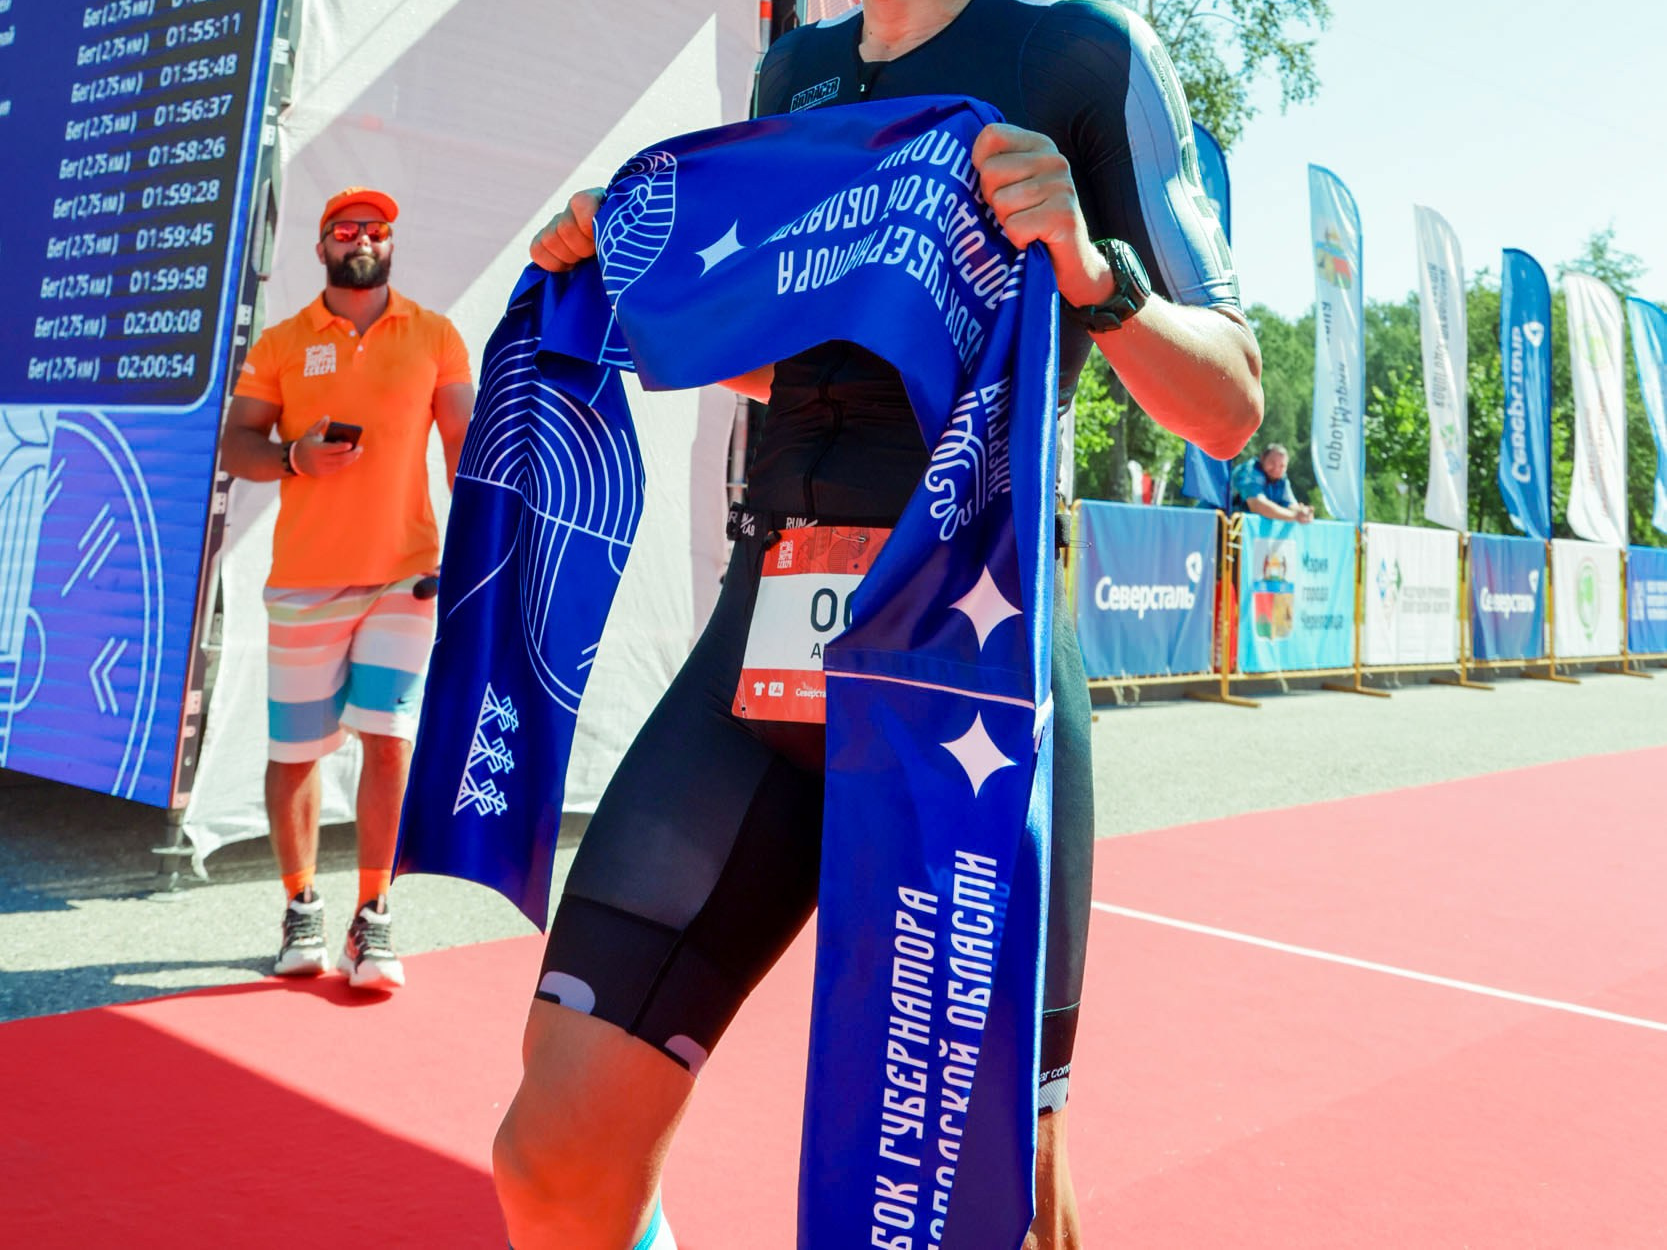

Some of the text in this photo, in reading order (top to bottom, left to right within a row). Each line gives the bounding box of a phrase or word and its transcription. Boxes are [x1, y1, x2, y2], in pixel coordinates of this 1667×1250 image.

[165, 12, 241, 48] 01:55:11
[159, 53, 238, 87] 01:55:48
[153, 94, 233, 127] 01:56:37
[148, 136, 227, 168] 01:58:26
[141, 178, 221, 210] 01:59:28
[135, 222, 214, 251] 01:59:45
[129, 265, 209, 294] 01:59:58
[123, 308, 203, 336] 02:00:08
[116, 354, 196, 380] 02:00:54
[1095, 576, 1195, 619] Северсталь
[946, 849, 998, 1031] ОБЛАСТИ
[879, 885, 938, 1168] ГУБЕРНАТОРА
